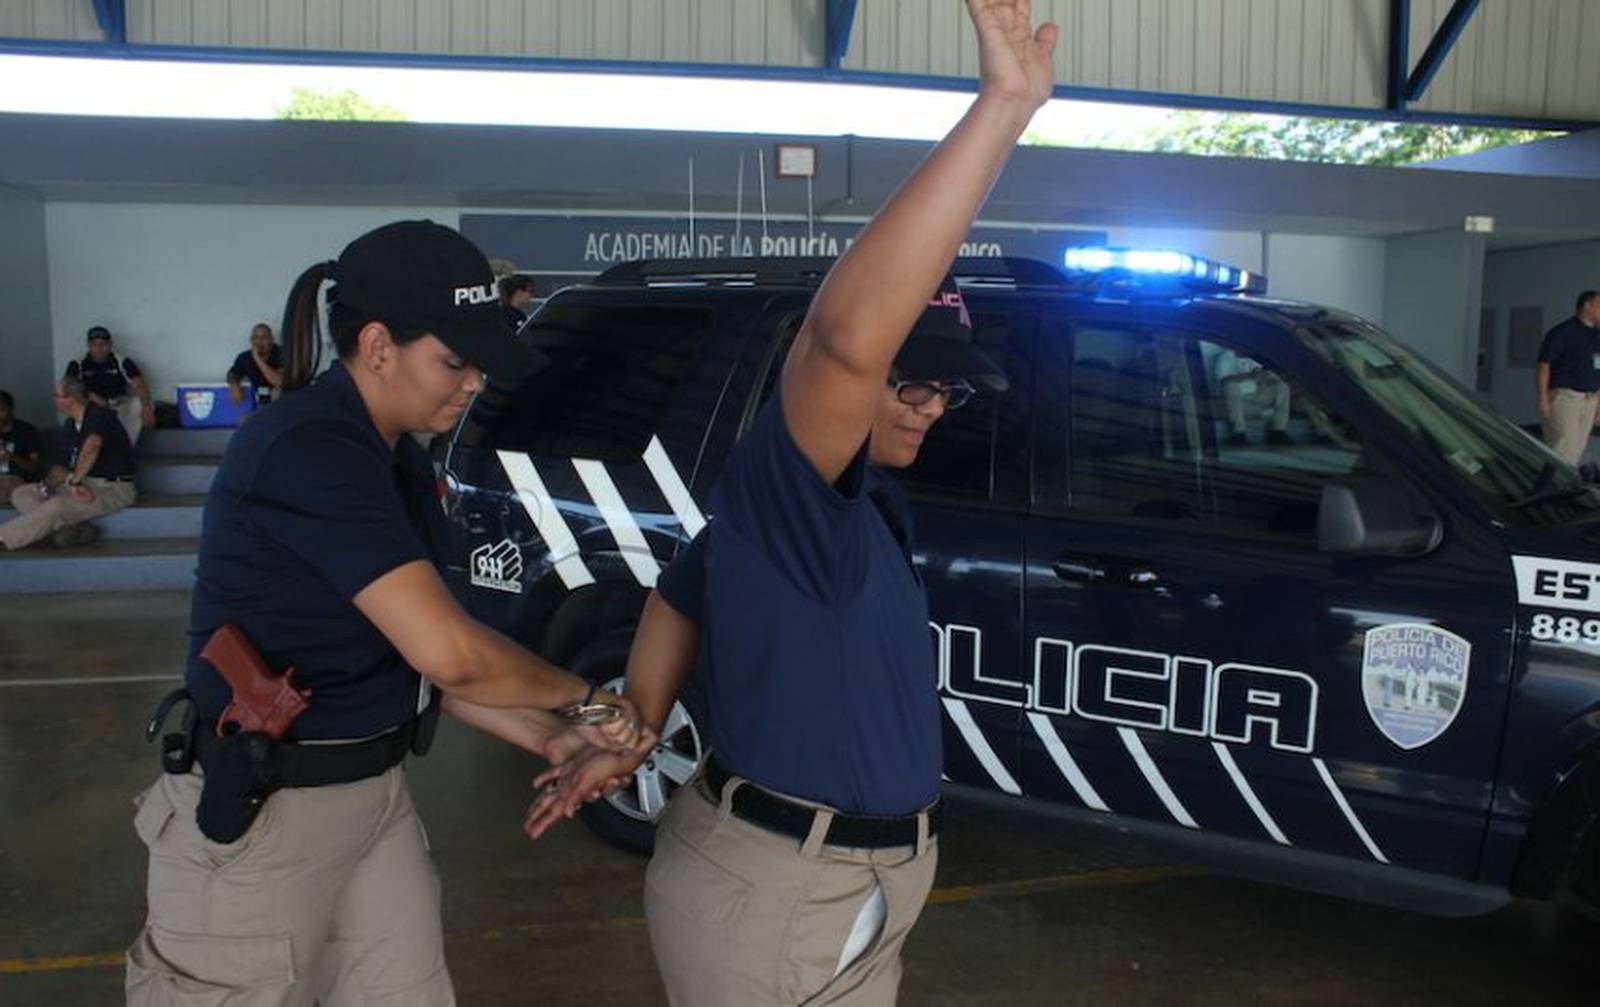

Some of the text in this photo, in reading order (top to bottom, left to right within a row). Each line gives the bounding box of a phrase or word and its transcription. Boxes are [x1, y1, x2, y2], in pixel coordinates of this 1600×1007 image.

[584, 232, 690, 261] ACADEMIA
[698, 234, 725, 258] DE
[730, 235, 754, 257] LA
[1530, 613, 1600, 645] 889
[929, 621, 1319, 753] LICIA
